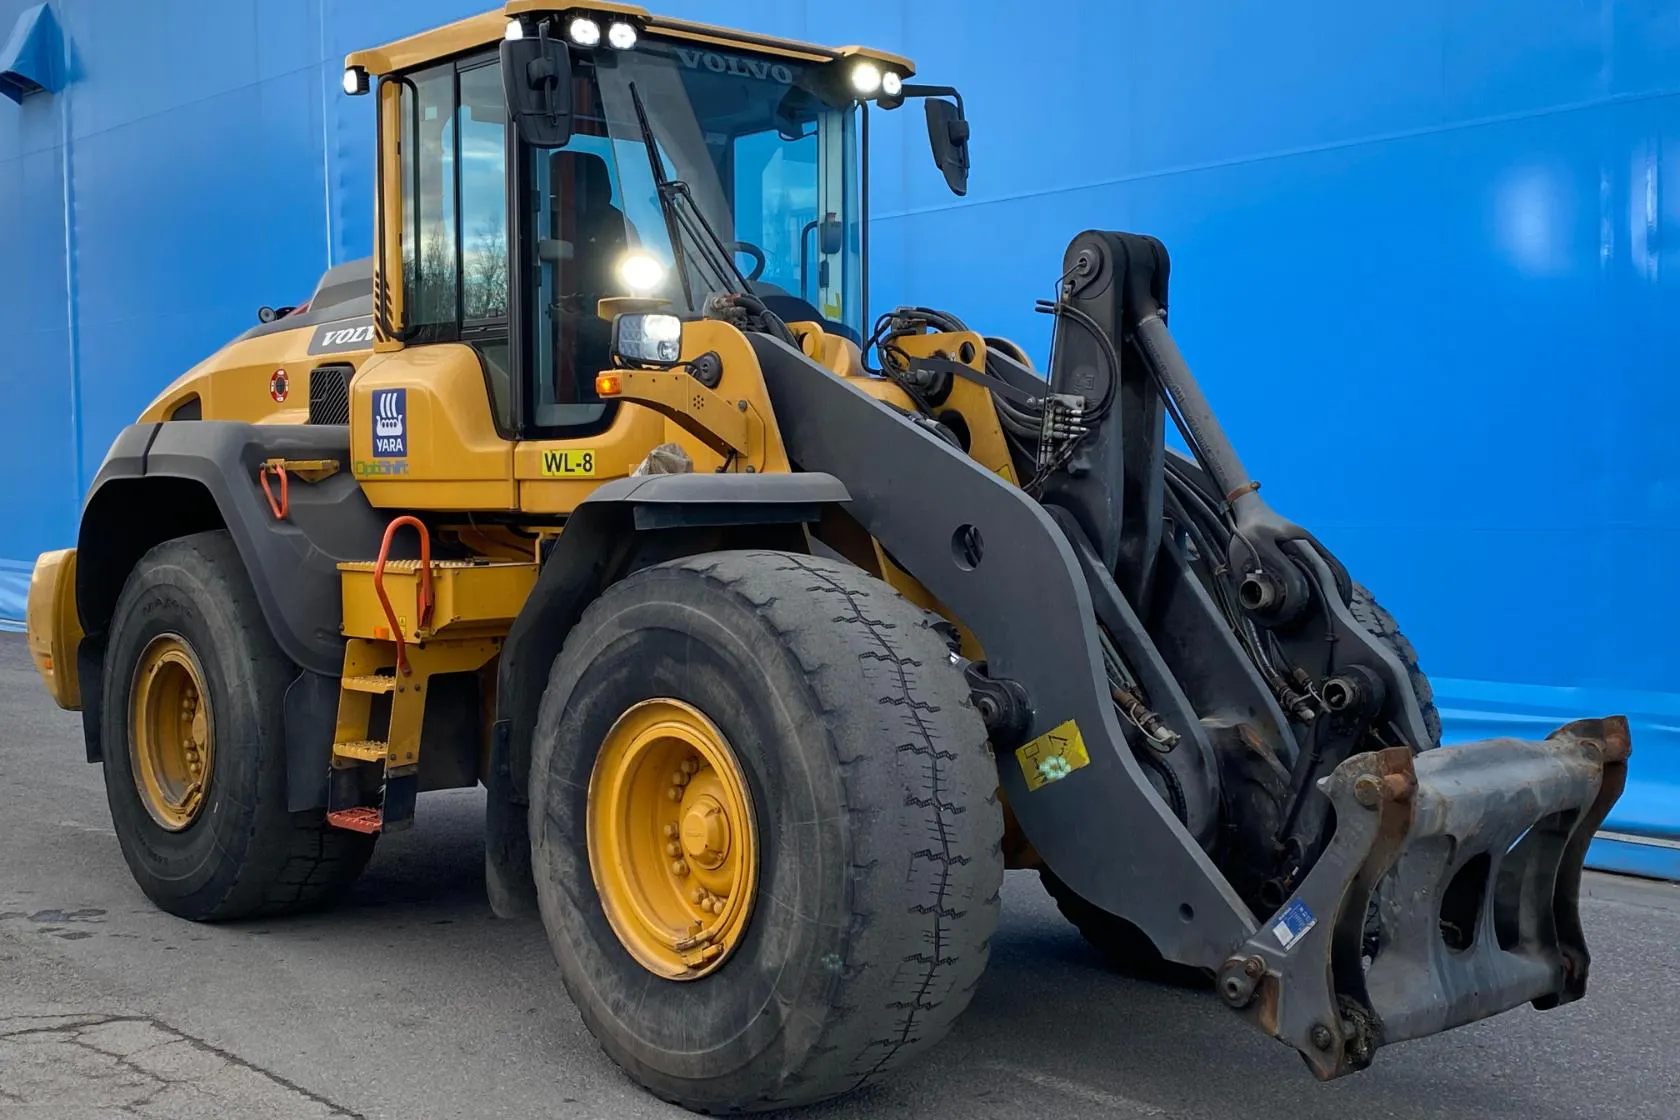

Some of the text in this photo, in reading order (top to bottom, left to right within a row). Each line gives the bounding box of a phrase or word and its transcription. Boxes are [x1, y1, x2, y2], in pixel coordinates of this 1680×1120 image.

[675, 48, 793, 84] VOLVO
[376, 438, 404, 453] YARA
[544, 452, 593, 473] WL-8
